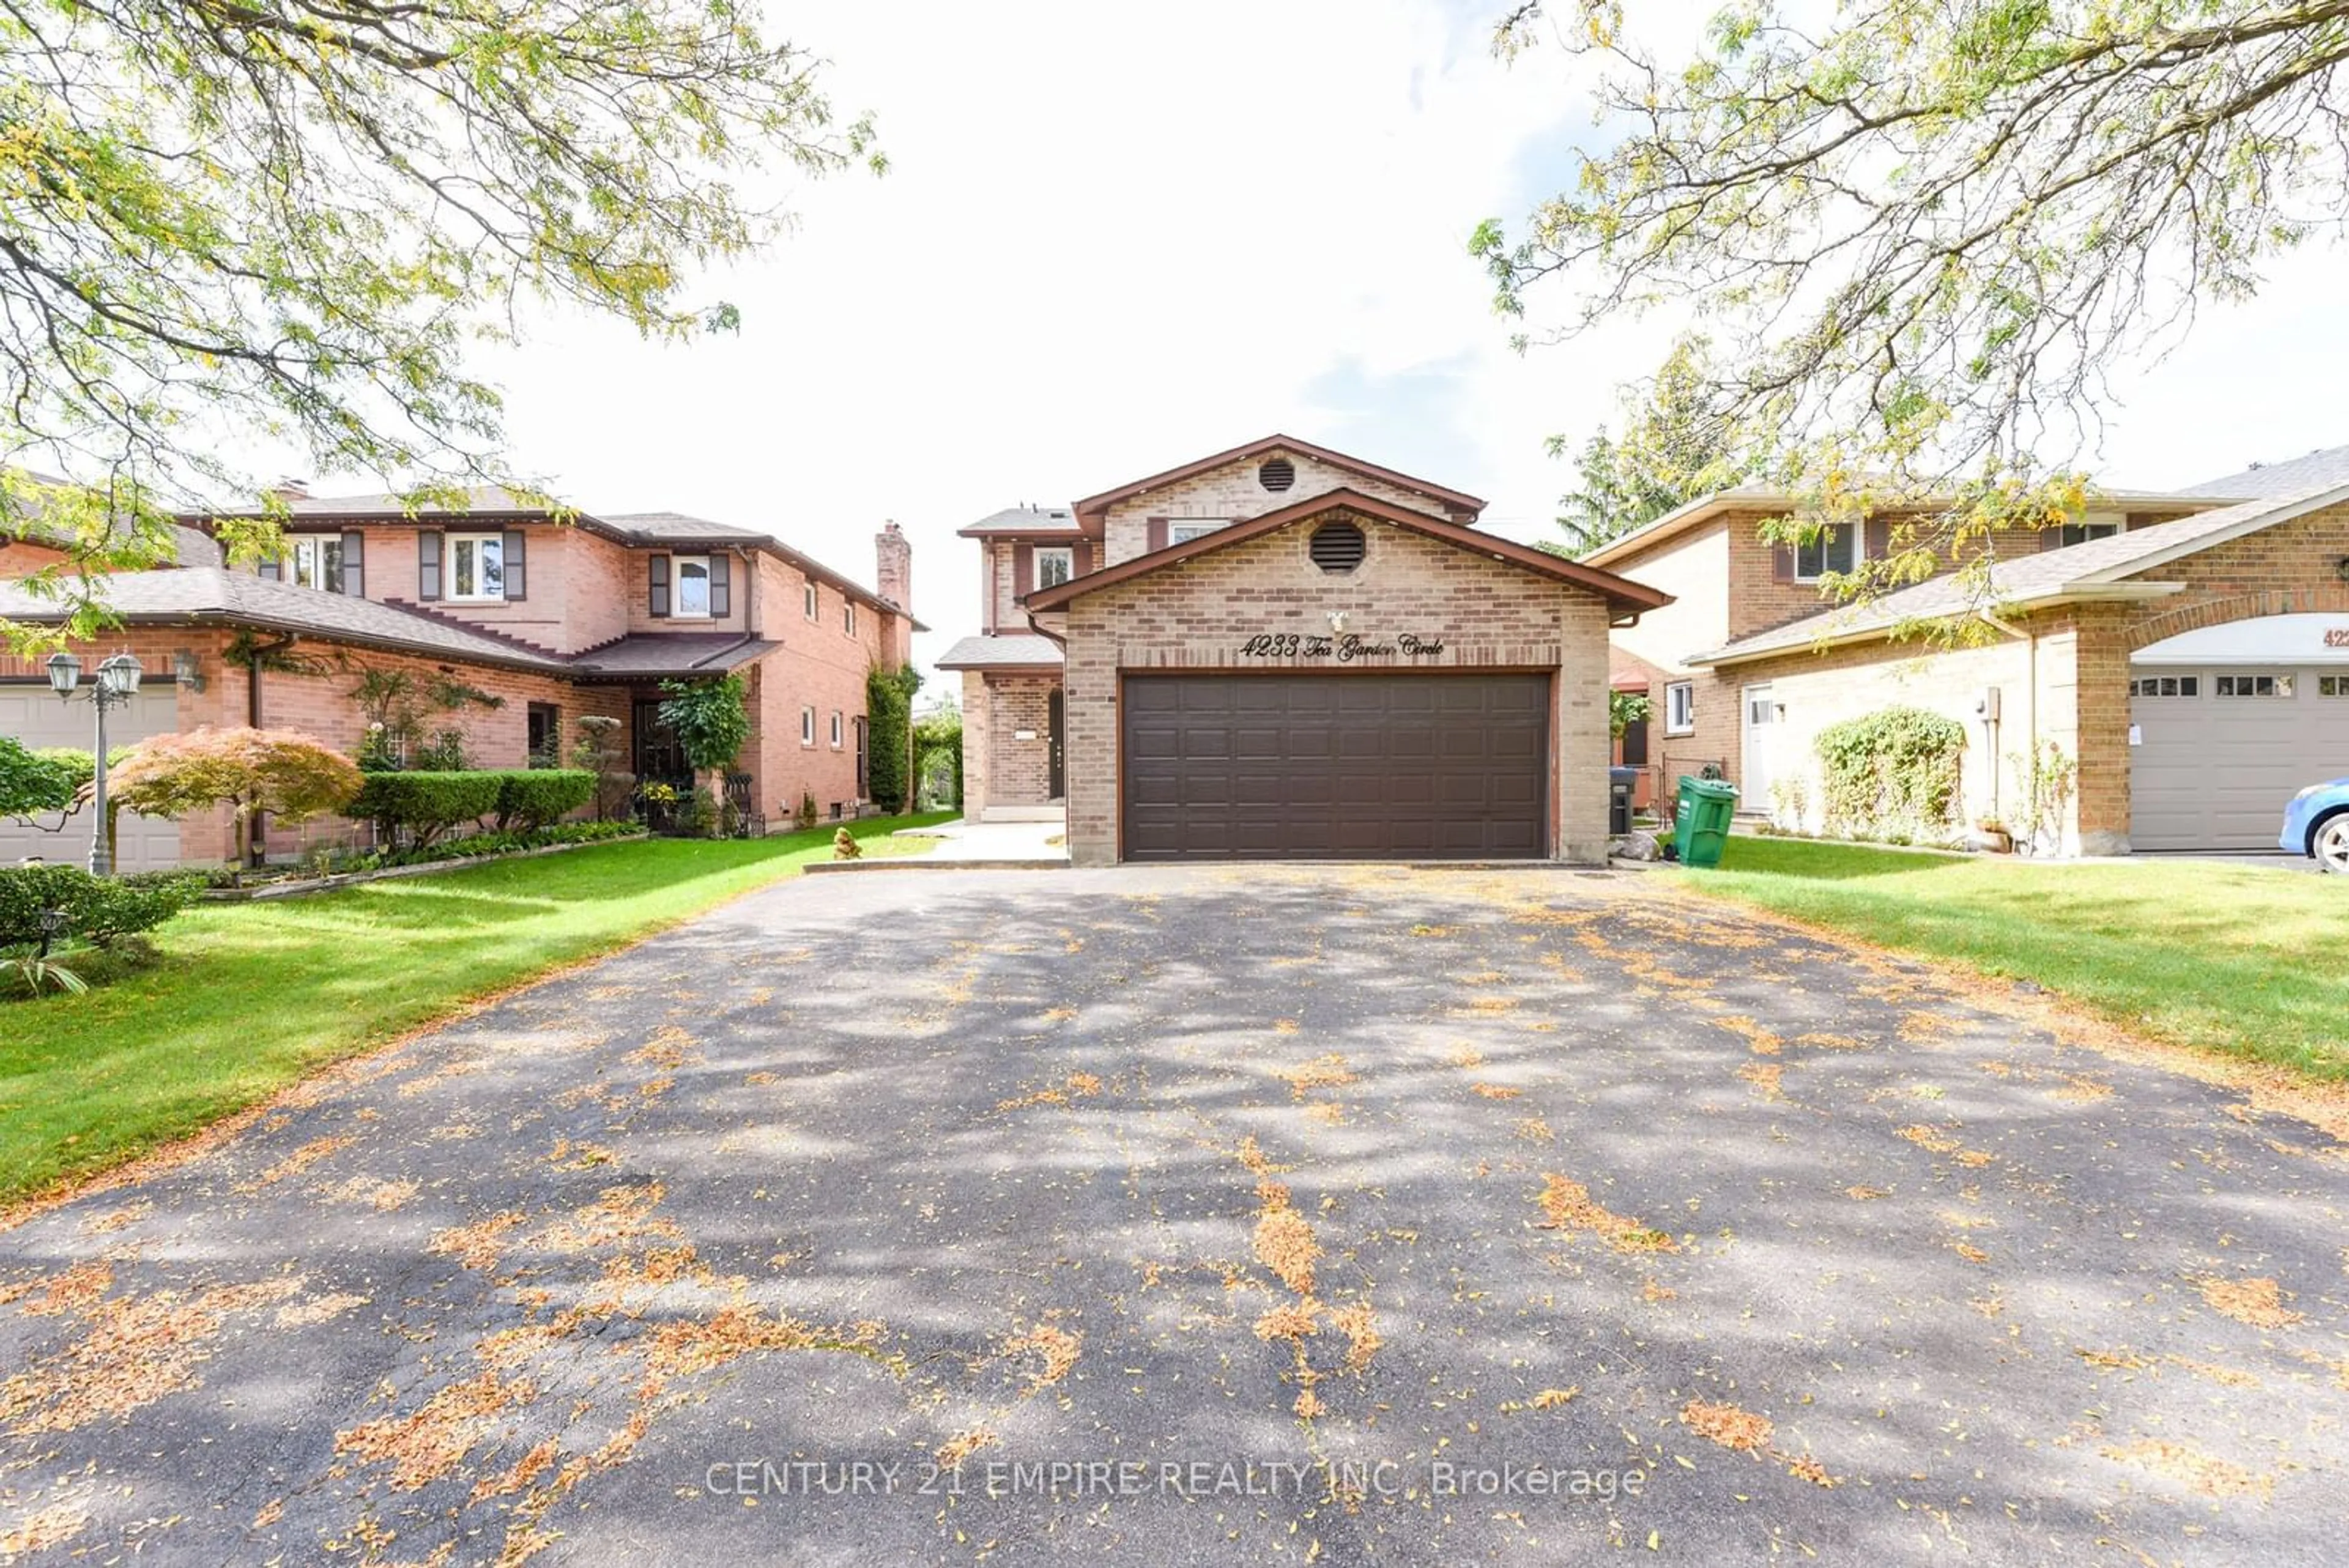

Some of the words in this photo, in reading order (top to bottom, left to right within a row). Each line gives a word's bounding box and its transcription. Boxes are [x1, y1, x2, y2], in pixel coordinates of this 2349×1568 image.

[1240, 634, 1300, 657] 4233
[1303, 636, 1333, 657] Tea
[1337, 634, 1397, 662] Garden
[1398, 633, 1444, 656] Circle
